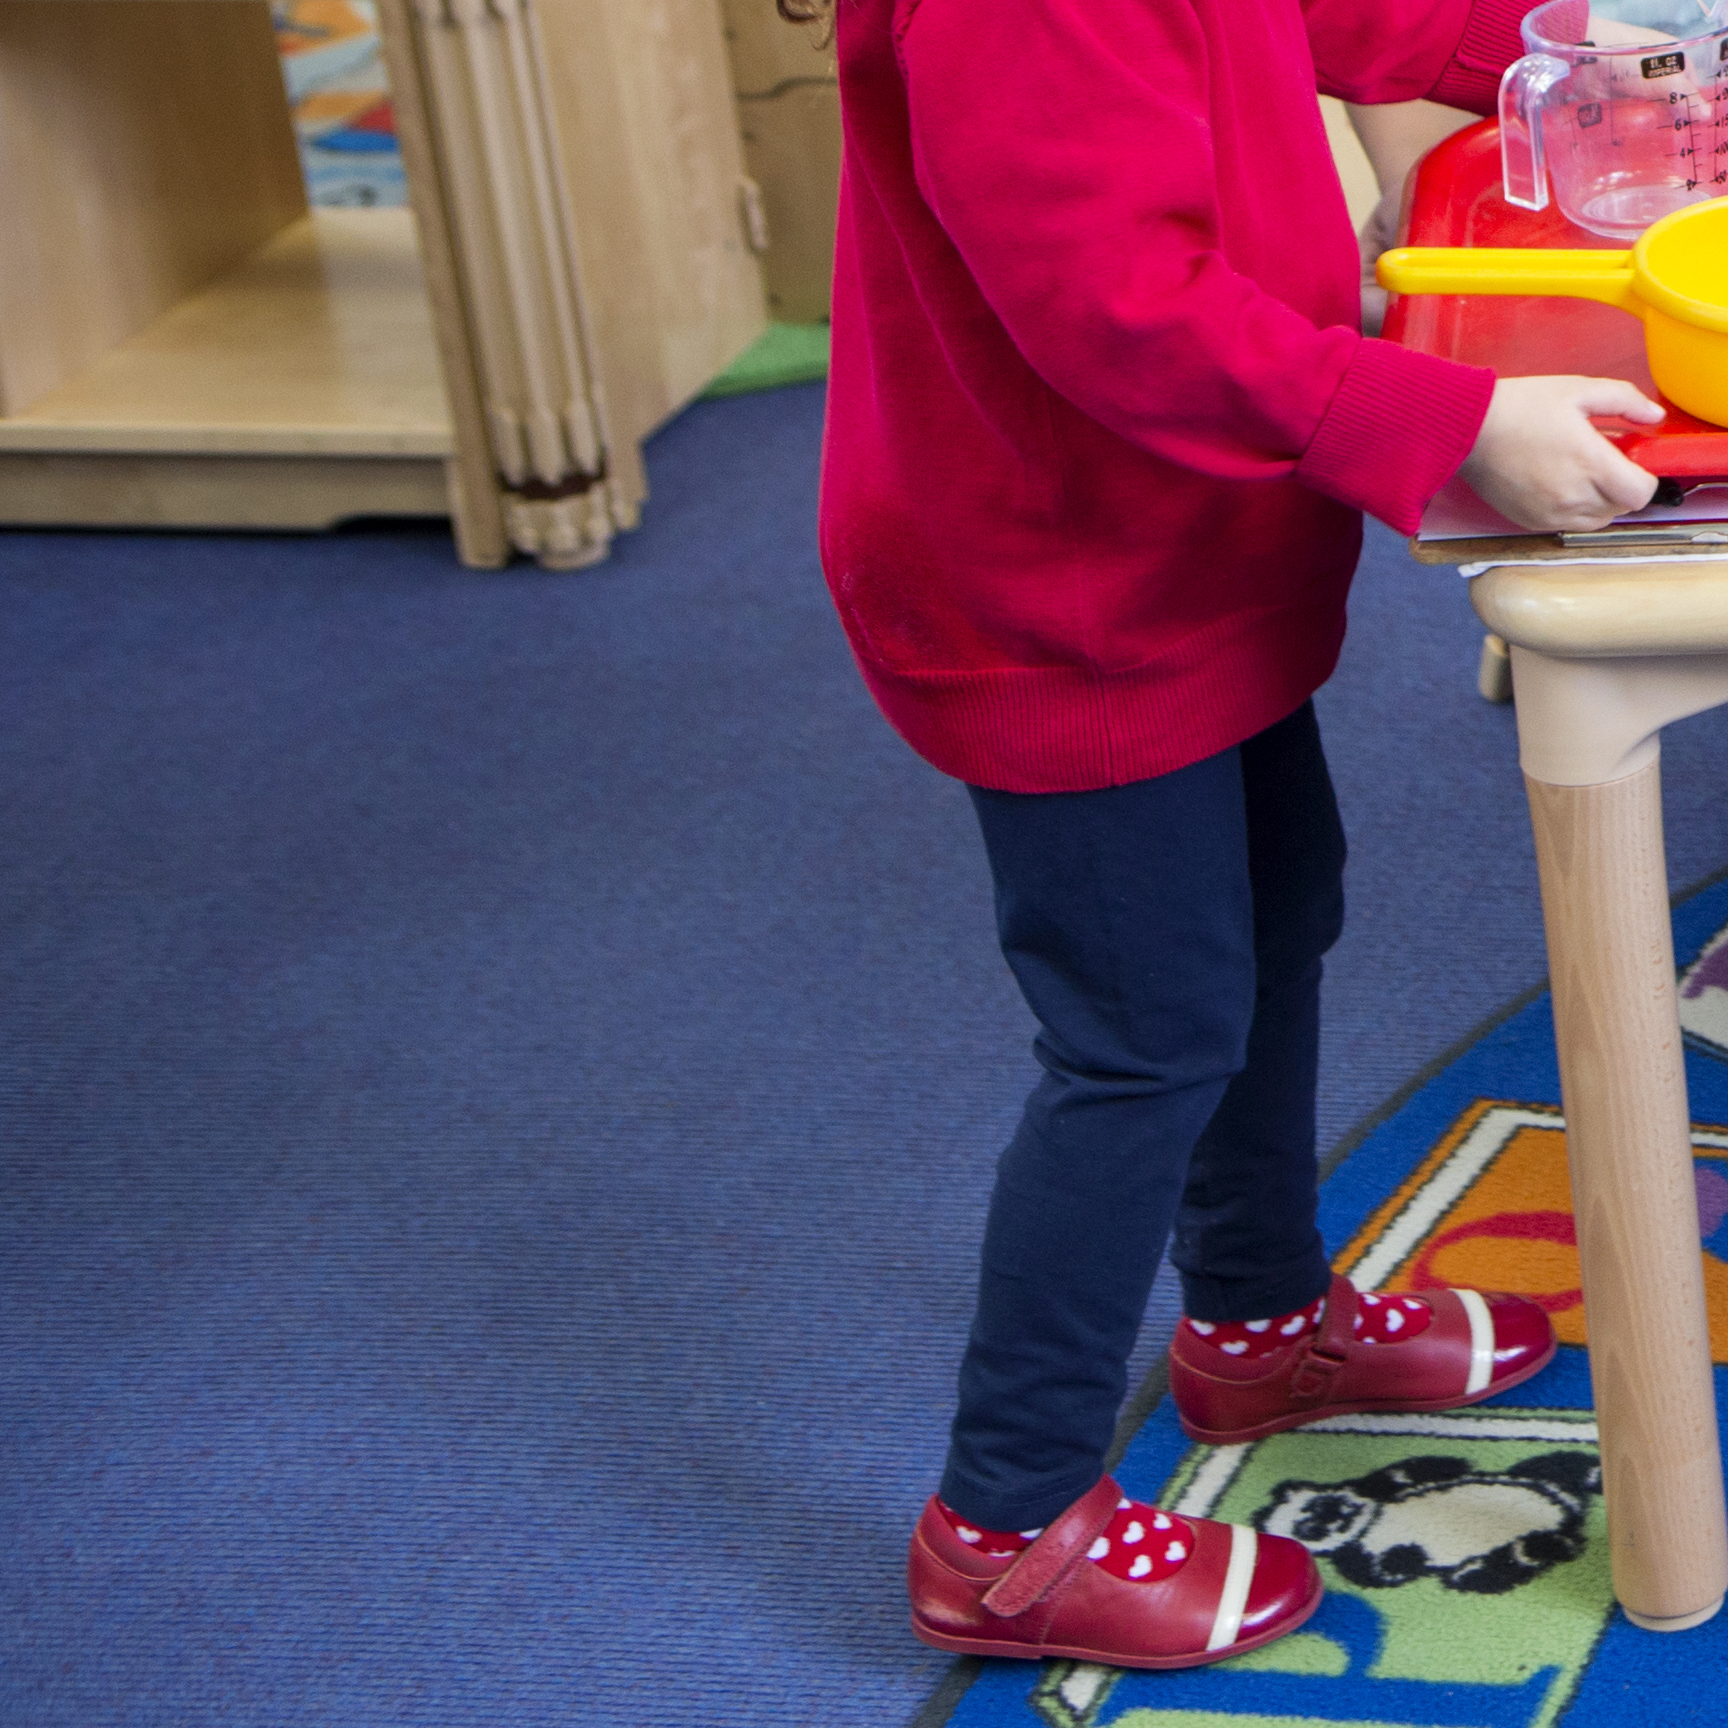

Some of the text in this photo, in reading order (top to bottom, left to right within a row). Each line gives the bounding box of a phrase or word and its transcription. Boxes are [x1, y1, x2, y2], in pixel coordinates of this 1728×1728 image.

[1669, 91, 1678, 104] 8
[1675, 118, 1682, 131] 6
[1680, 147, 1686, 158] 4
